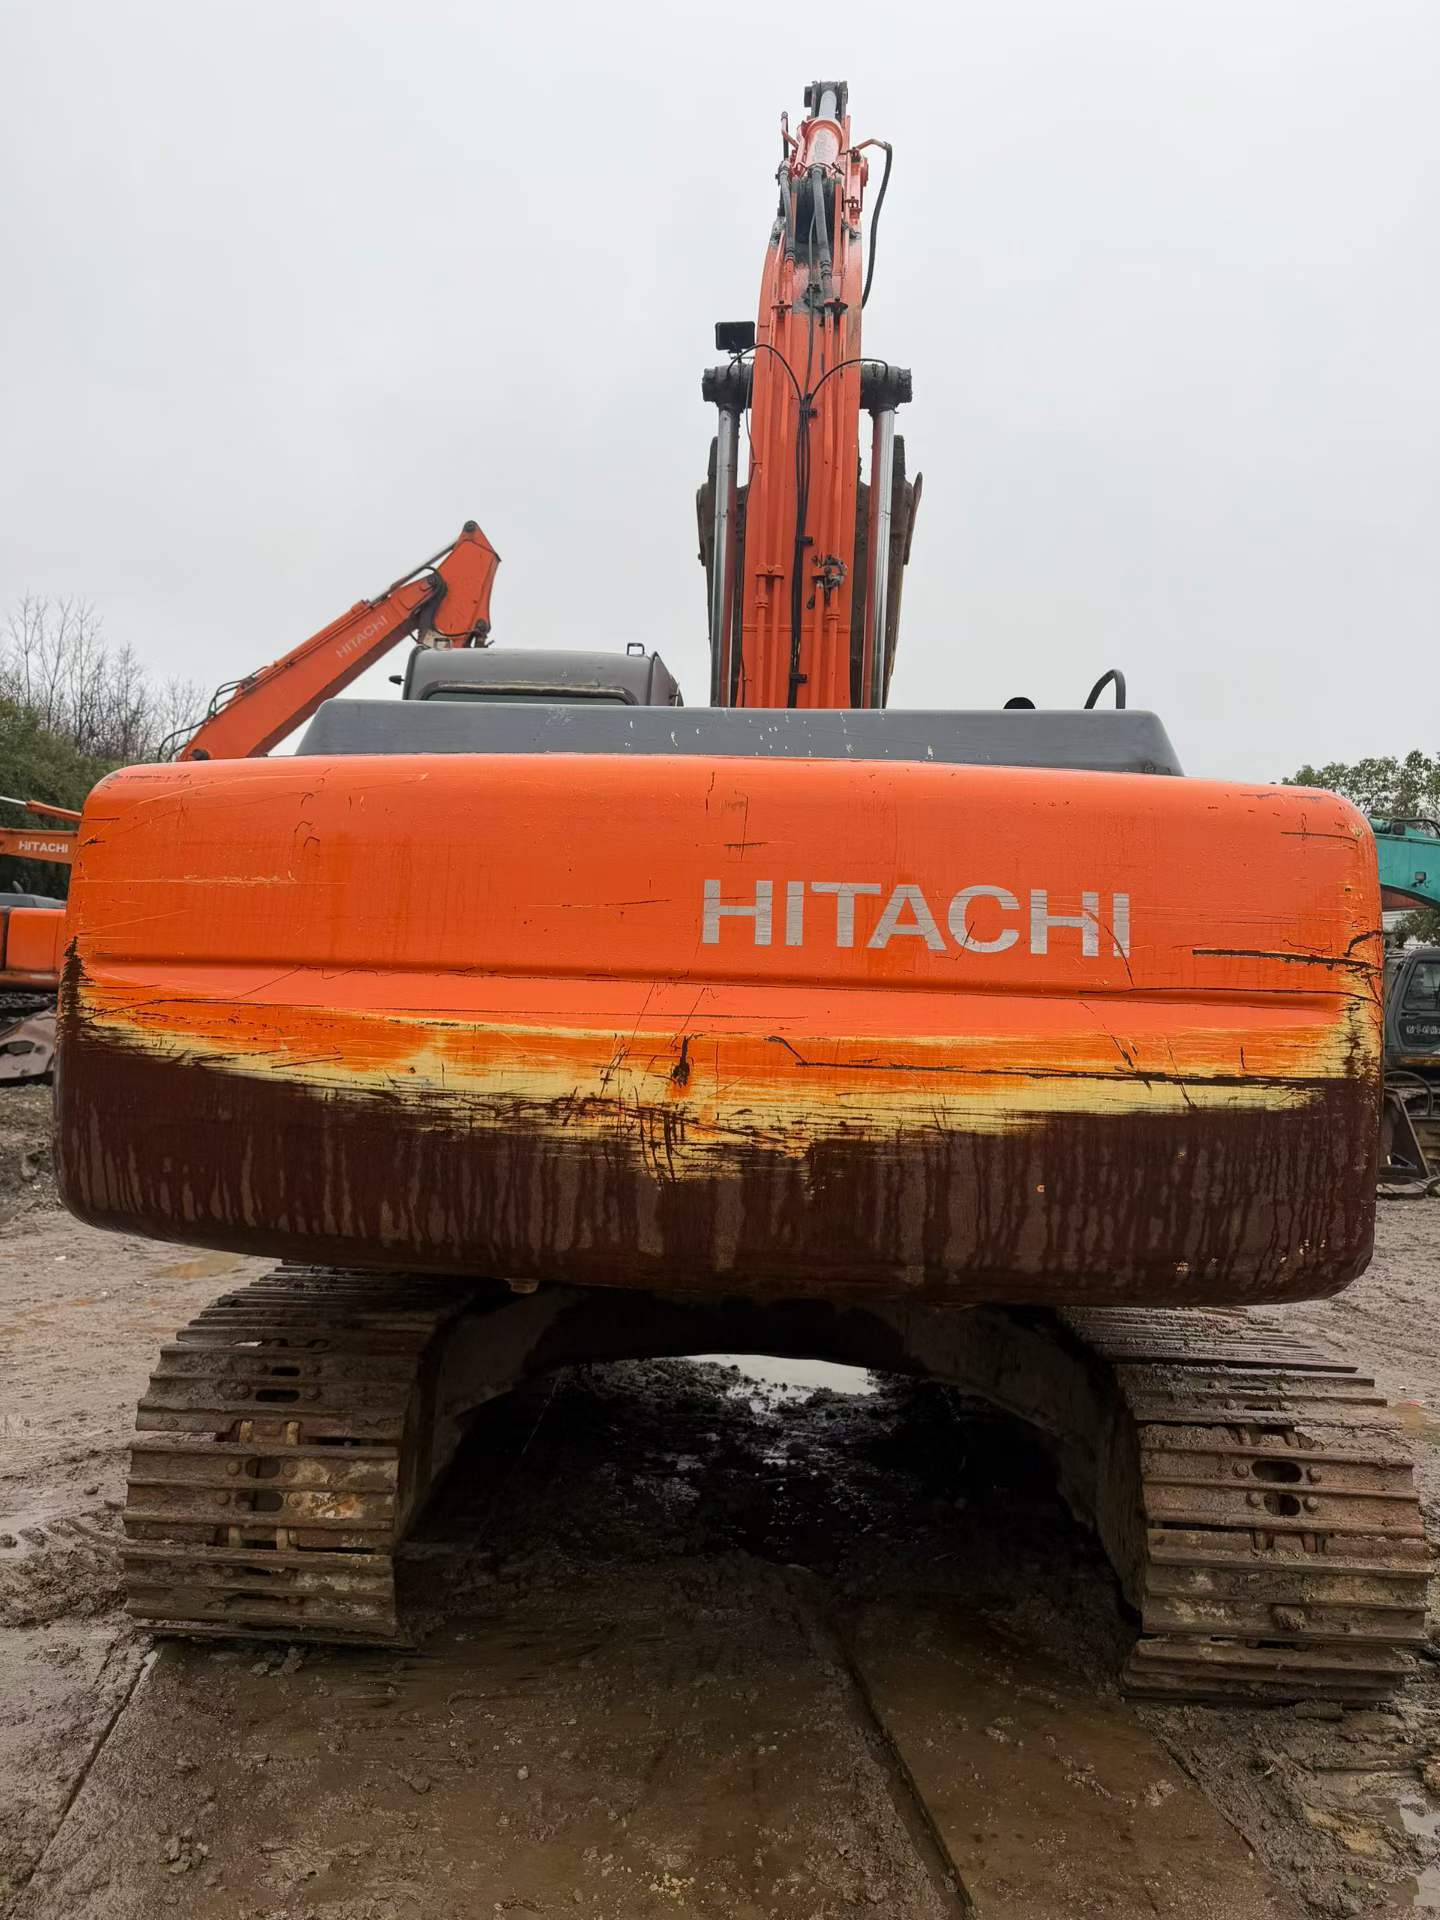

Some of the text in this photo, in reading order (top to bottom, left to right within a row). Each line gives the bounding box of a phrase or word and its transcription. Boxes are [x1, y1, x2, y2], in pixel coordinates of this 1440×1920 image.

[335, 615, 388, 658] HITACHI
[18, 840, 69, 853] HITACHI
[702, 879, 1130, 957] HITACHI
